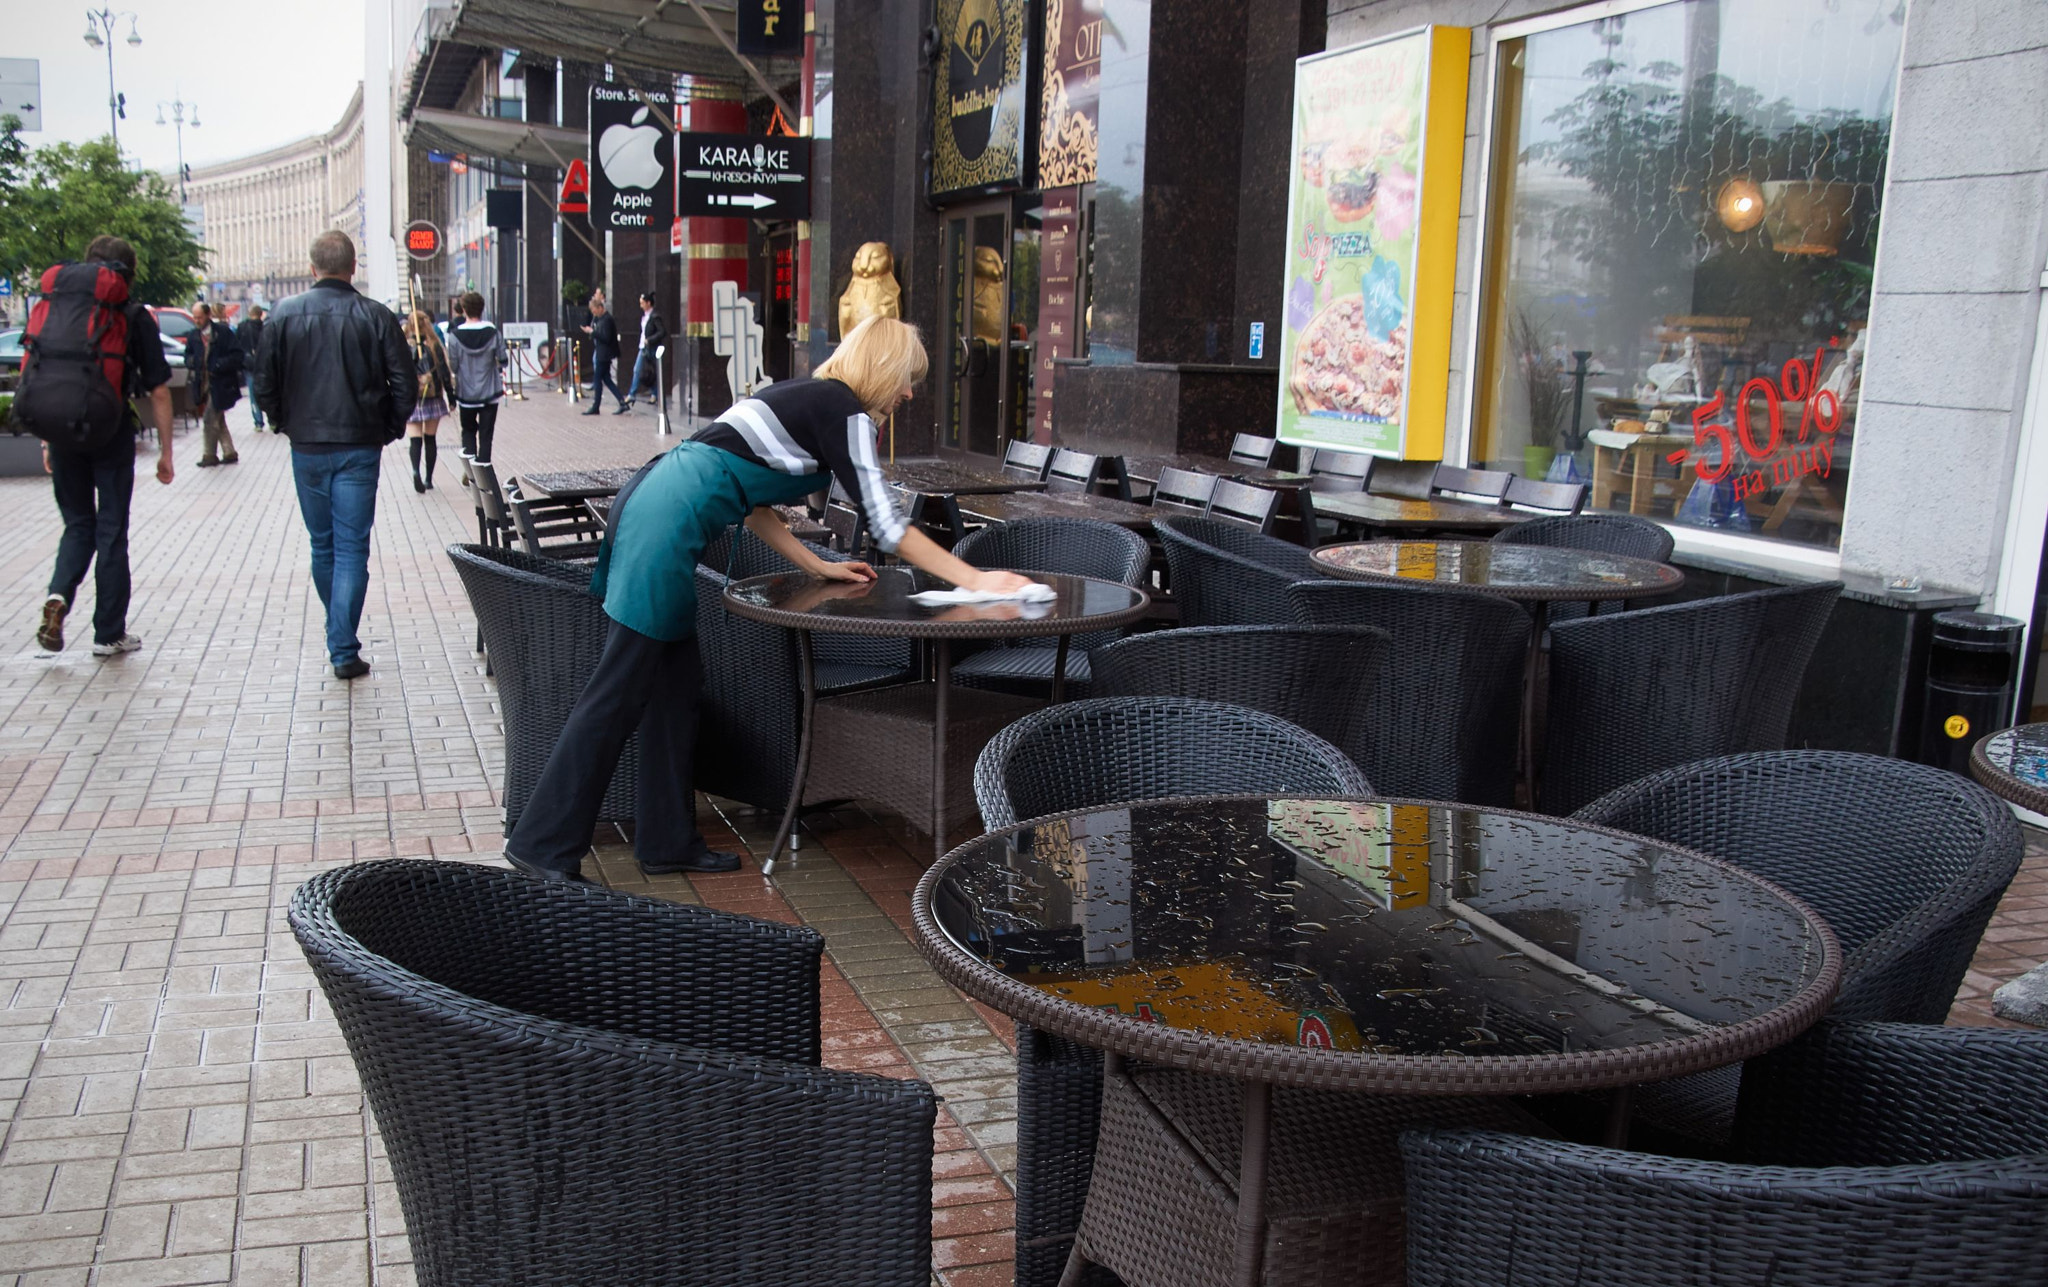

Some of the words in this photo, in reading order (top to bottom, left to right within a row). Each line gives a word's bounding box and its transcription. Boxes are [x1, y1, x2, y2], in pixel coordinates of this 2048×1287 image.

[595, 86, 626, 102] Store.
[628, 88, 669, 103] Sevice.
[951, 84, 1000, 118] buddha-bar
[699, 144, 789, 171] KARAOKE
[613, 192, 652, 210] Apple
[1732, 469, 1765, 502] на
[1770, 438, 1836, 485] піцу
